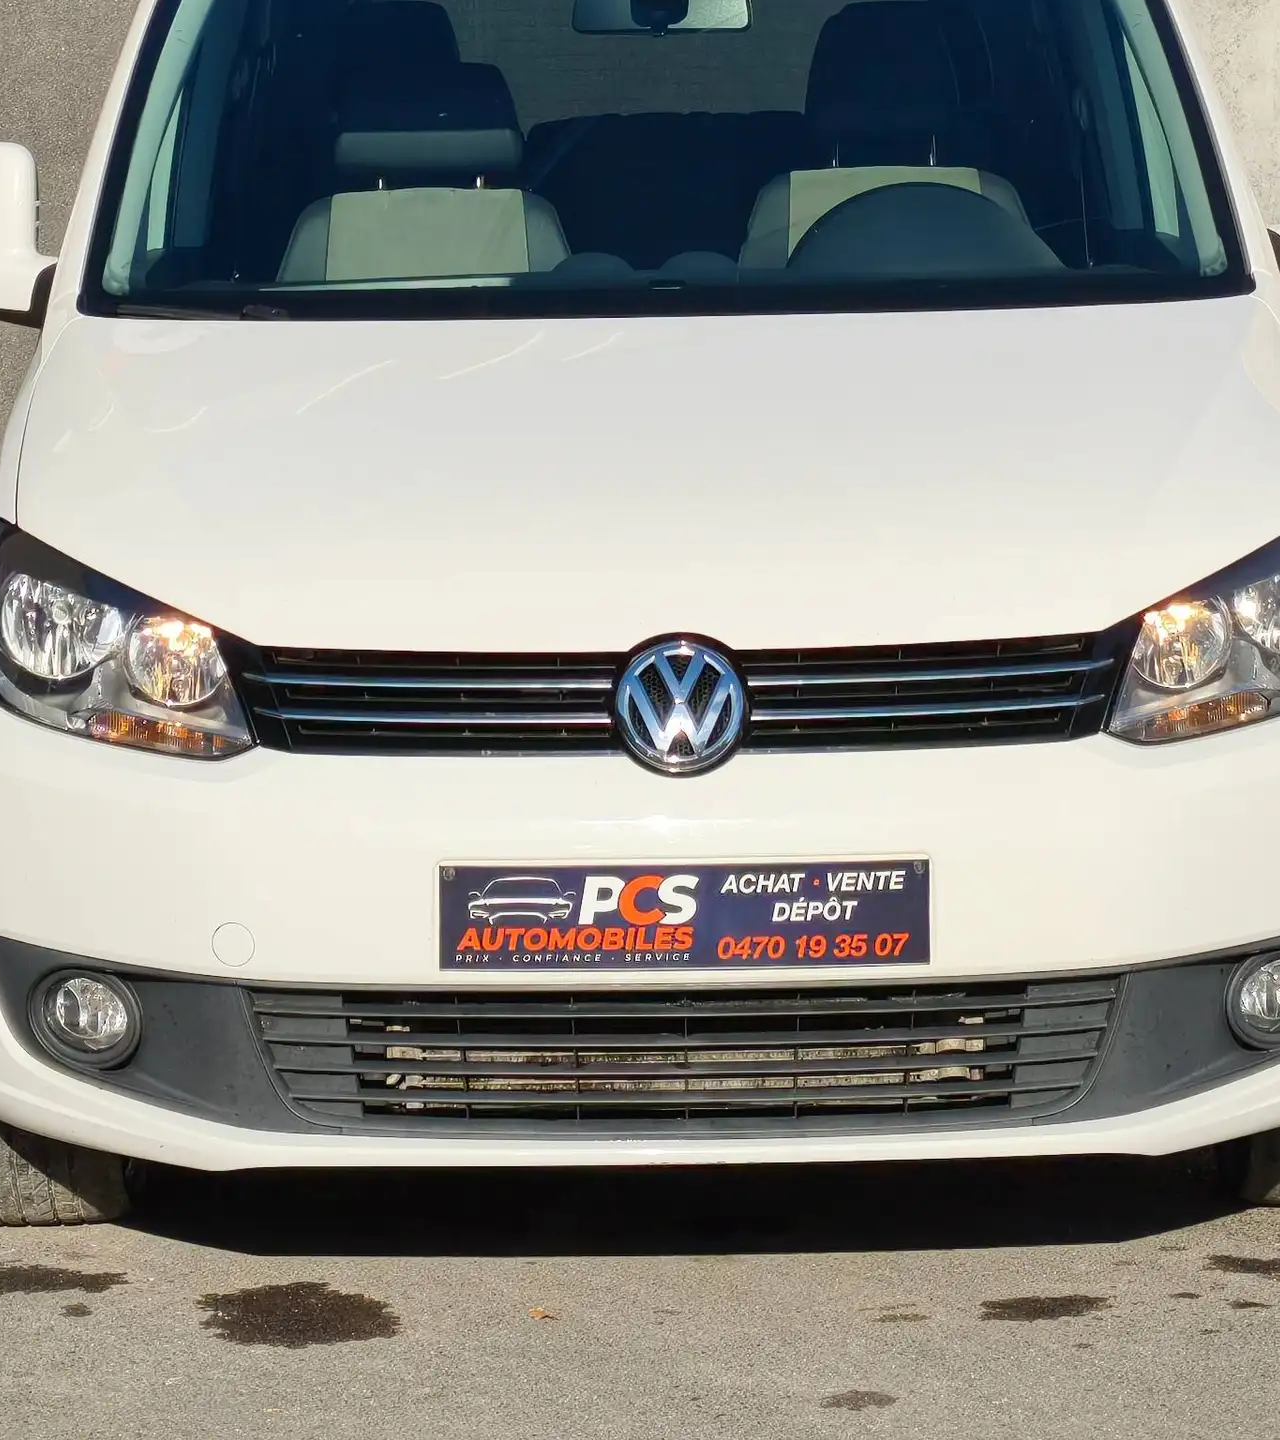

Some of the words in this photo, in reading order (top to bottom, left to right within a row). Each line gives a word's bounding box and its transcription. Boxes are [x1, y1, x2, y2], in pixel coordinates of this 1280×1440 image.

[720, 873, 806, 894] ACHAT
[826, 870, 906, 892] VENTE
[578, 874, 700, 926] PCS
[772, 896, 858, 922] DÉPÔT
[456, 926, 694, 951] AUTOMOBILES
[717, 935, 786, 960] 0470
[795, 934, 827, 959] 19
[833, 933, 868, 957] 35
[874, 931, 910, 956] 07
[455, 953, 489, 963] PRIX
[512, 953, 602, 963] CONFIANCE
[624, 952, 691, 963] SERVICE
